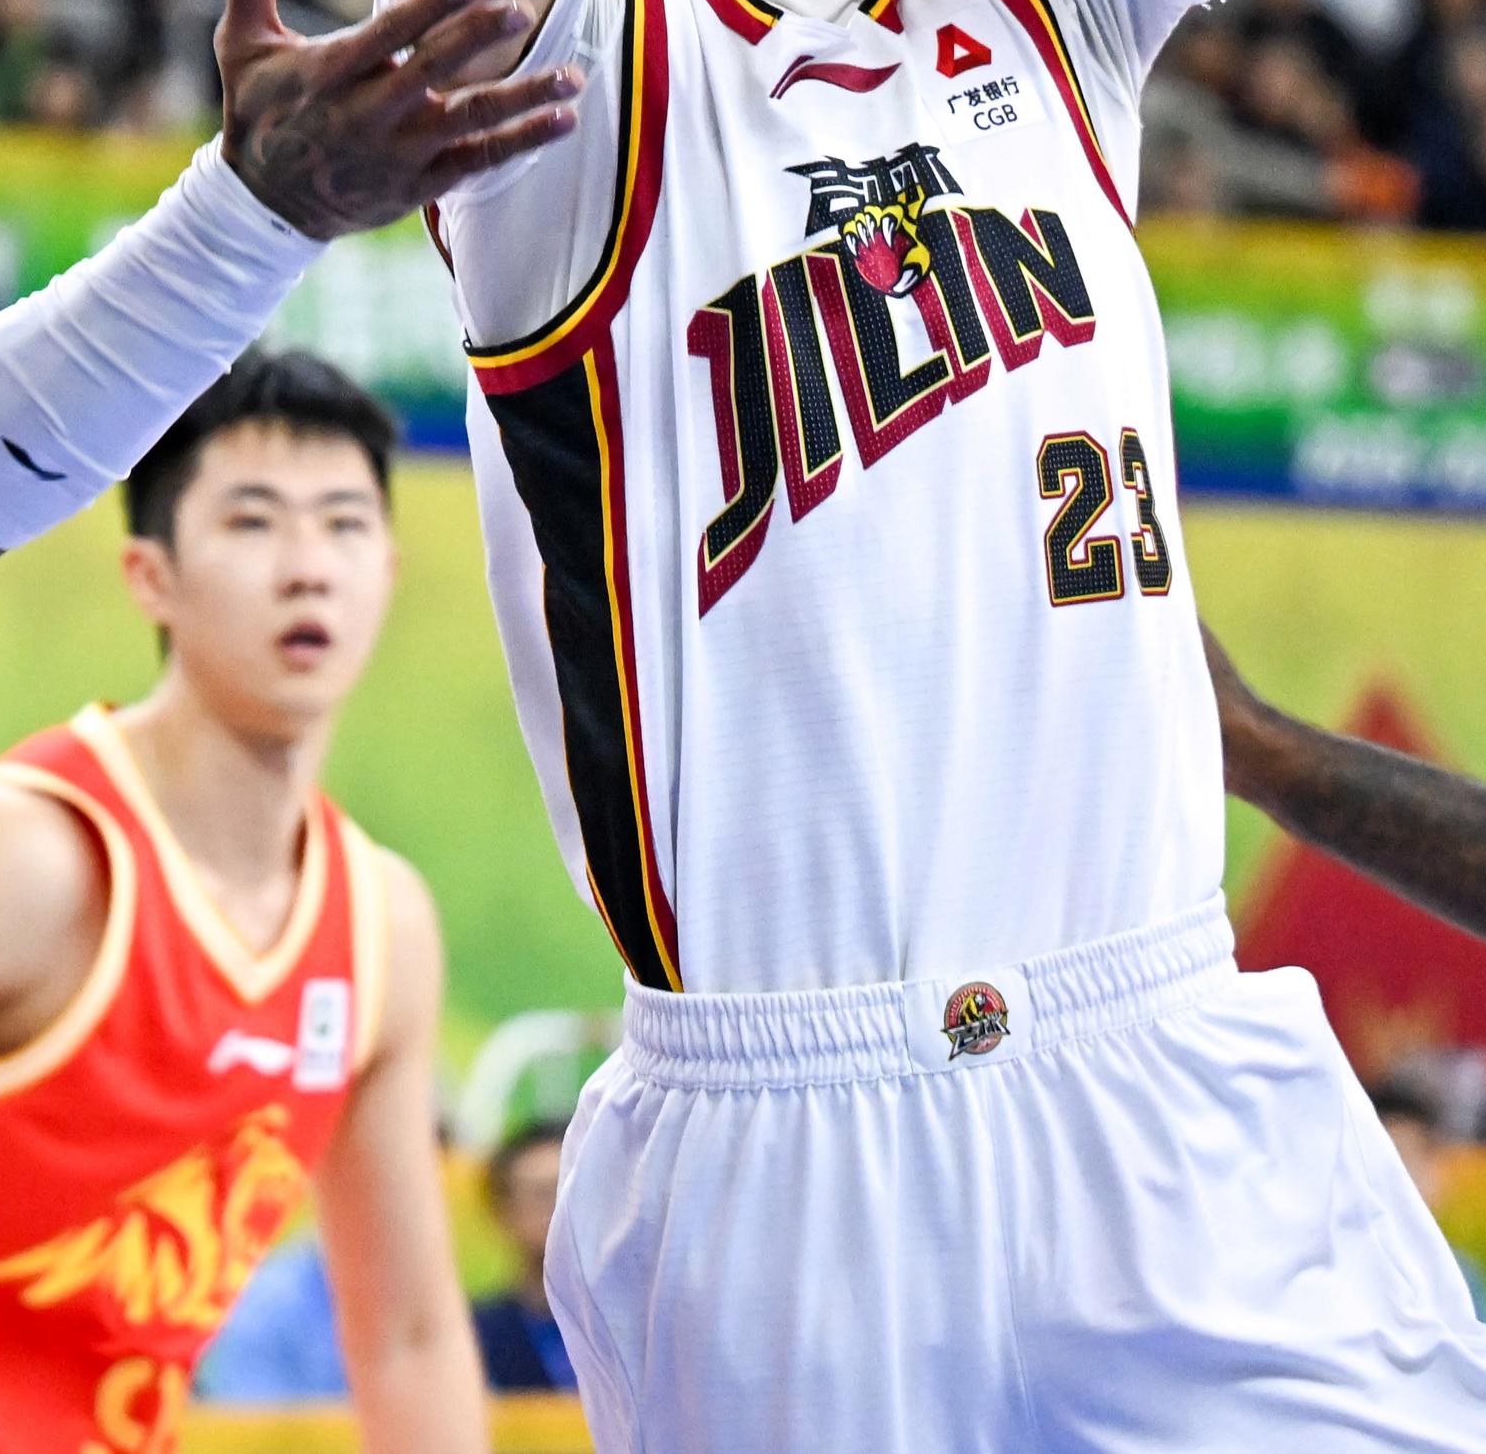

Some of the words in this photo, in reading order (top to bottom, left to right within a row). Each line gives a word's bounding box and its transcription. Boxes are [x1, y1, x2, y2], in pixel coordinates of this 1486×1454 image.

[947, 76, 1020, 114] 广发银行
[973, 104, 1018, 131] CGB
[687, 206, 1096, 620] JILIN
[1036, 426, 1172, 607] 23
